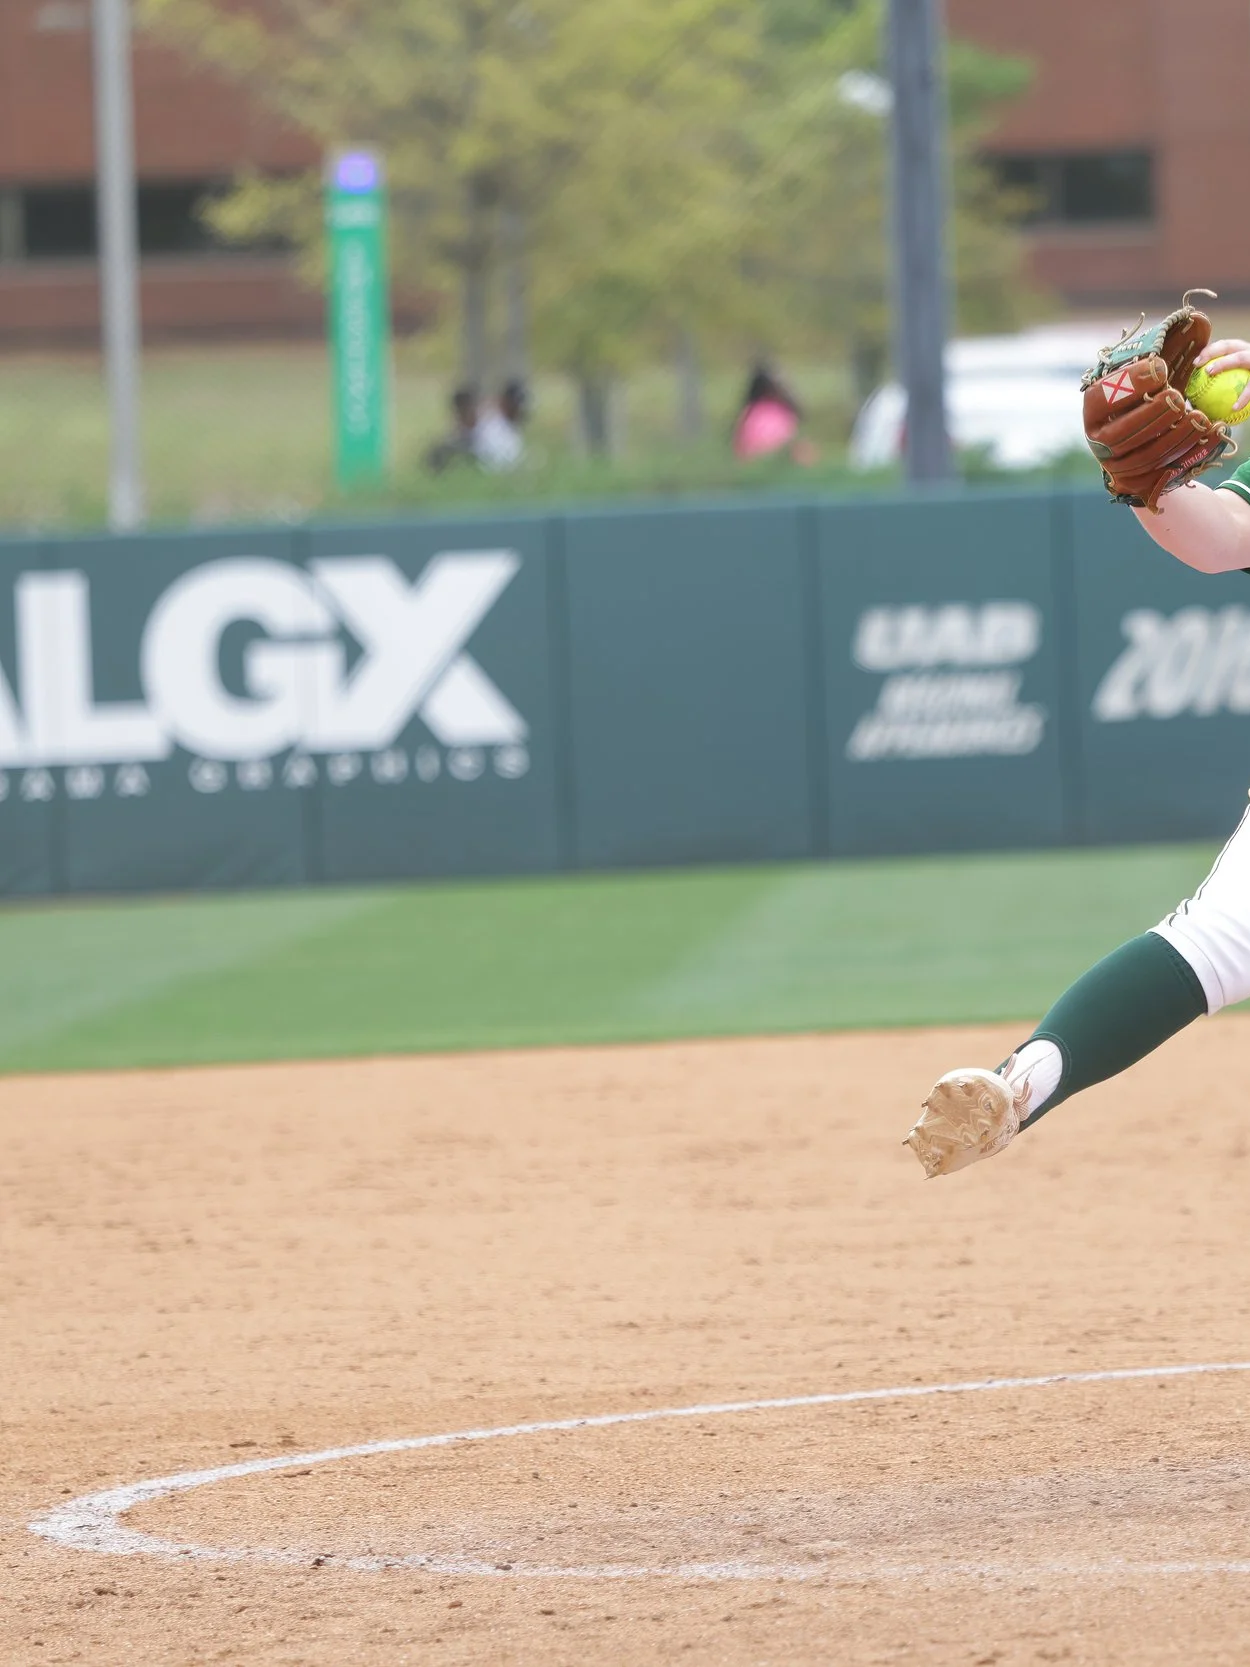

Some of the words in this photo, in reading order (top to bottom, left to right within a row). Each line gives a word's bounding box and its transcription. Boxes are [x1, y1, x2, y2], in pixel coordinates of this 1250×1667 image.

[0, 548, 528, 769] LGX
[853, 599, 1042, 671] UAB
[188, 742, 530, 793] GRAPHICS
